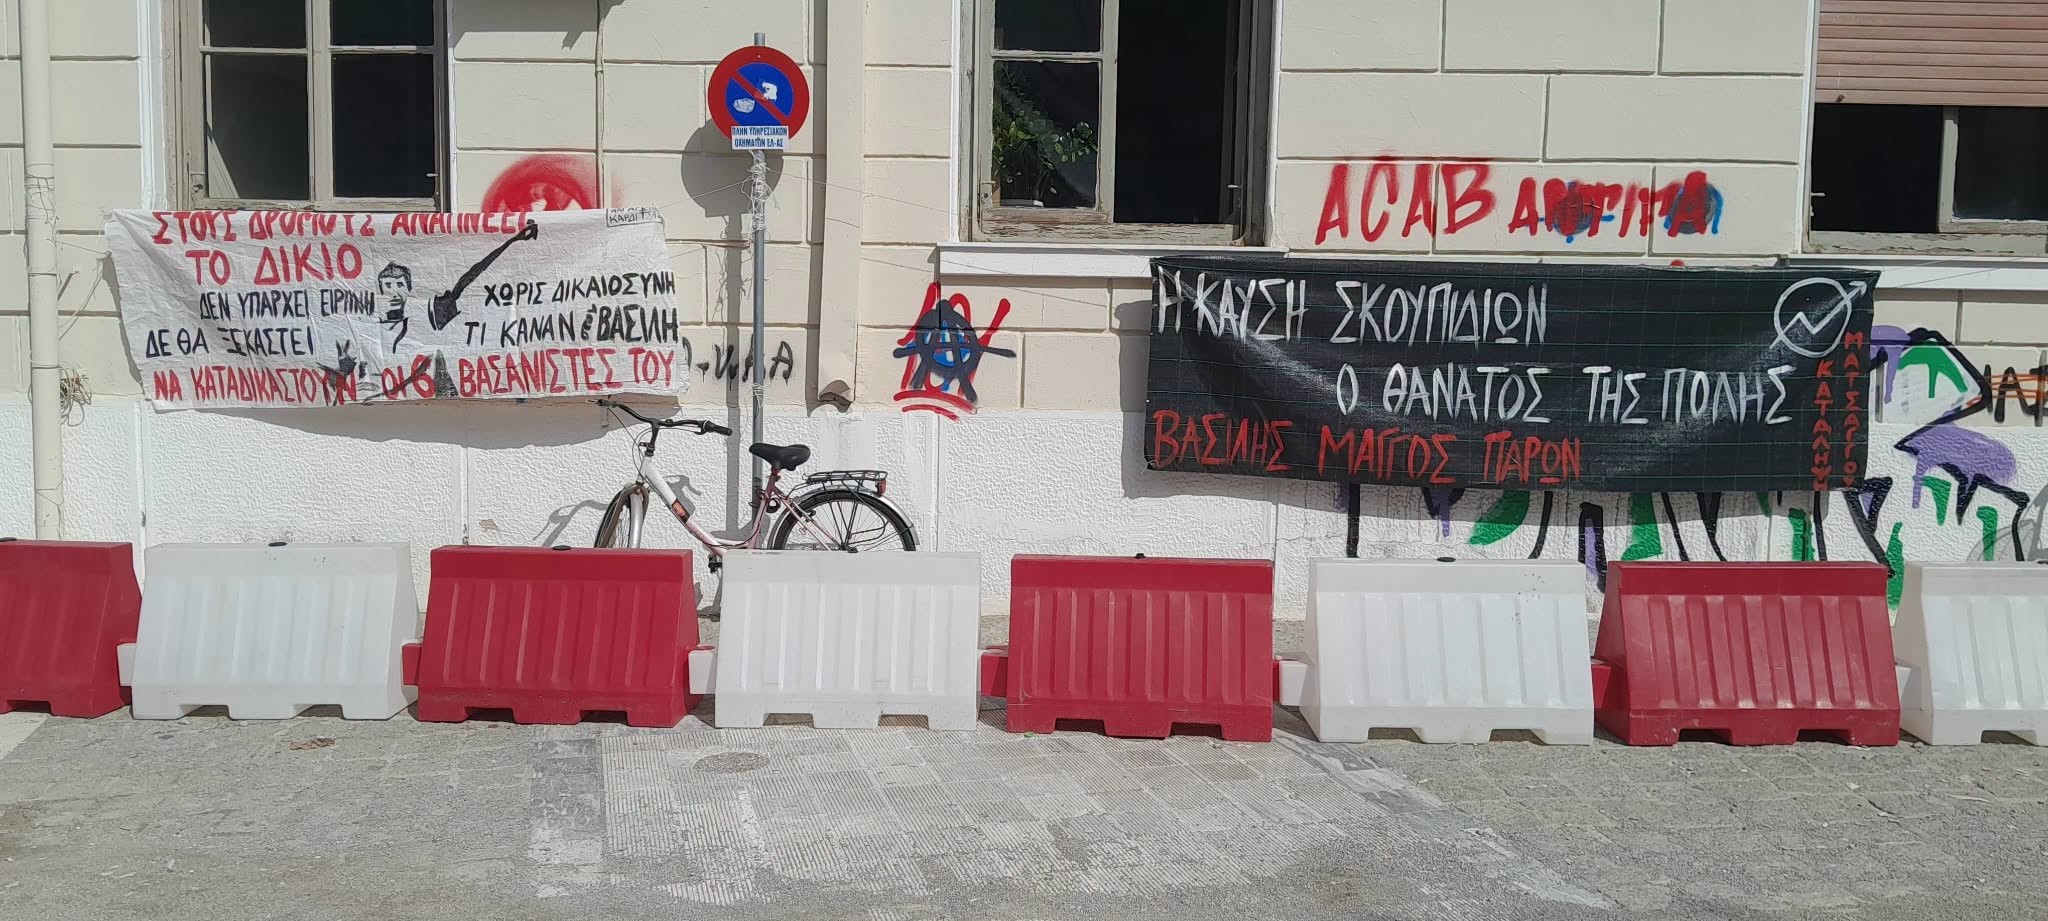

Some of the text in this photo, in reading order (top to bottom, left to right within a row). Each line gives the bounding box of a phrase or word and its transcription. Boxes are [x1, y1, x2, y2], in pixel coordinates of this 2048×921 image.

[1315, 158, 1496, 245] ACAB
[151, 210, 239, 245] ΣΤΟΥΣ
[185, 242, 363, 286] ΤΟ ΔΙΚΙΟ
[552, 271, 676, 304] ΔΙΚΑΙΟΣΥΝΗ
[200, 291, 231, 321] ΔΕΝ
[237, 290, 310, 321] ΥΠΑΡΧΕΙ
[464, 321, 486, 346] ΤΙ
[500, 310, 576, 348] ΚΑΝΑΝ
[596, 304, 679, 344] ΒΑΣΙΛΗ
[1157, 265, 1548, 350] Η ΚΑΥΣΗ ΣΚΟΥΠΙΔΙΩΝ
[153, 369, 183, 401] ΝΑ
[382, 366, 406, 399] ΟΙ
[458, 347, 623, 397] ΒΑΣΑΝΙΣΤΕΣ
[627, 346, 675, 388] ΤΟΥ
[1336, 362, 1797, 425] Ο ΘΑΝΑΤΟΣ ΤΗΣ ΠΟΛΗΣ
[1153, 409, 1581, 484] ΒΑΣΙΛΗΣ ΜΑΓΓΟΣ ΠΑΡΩΝ
